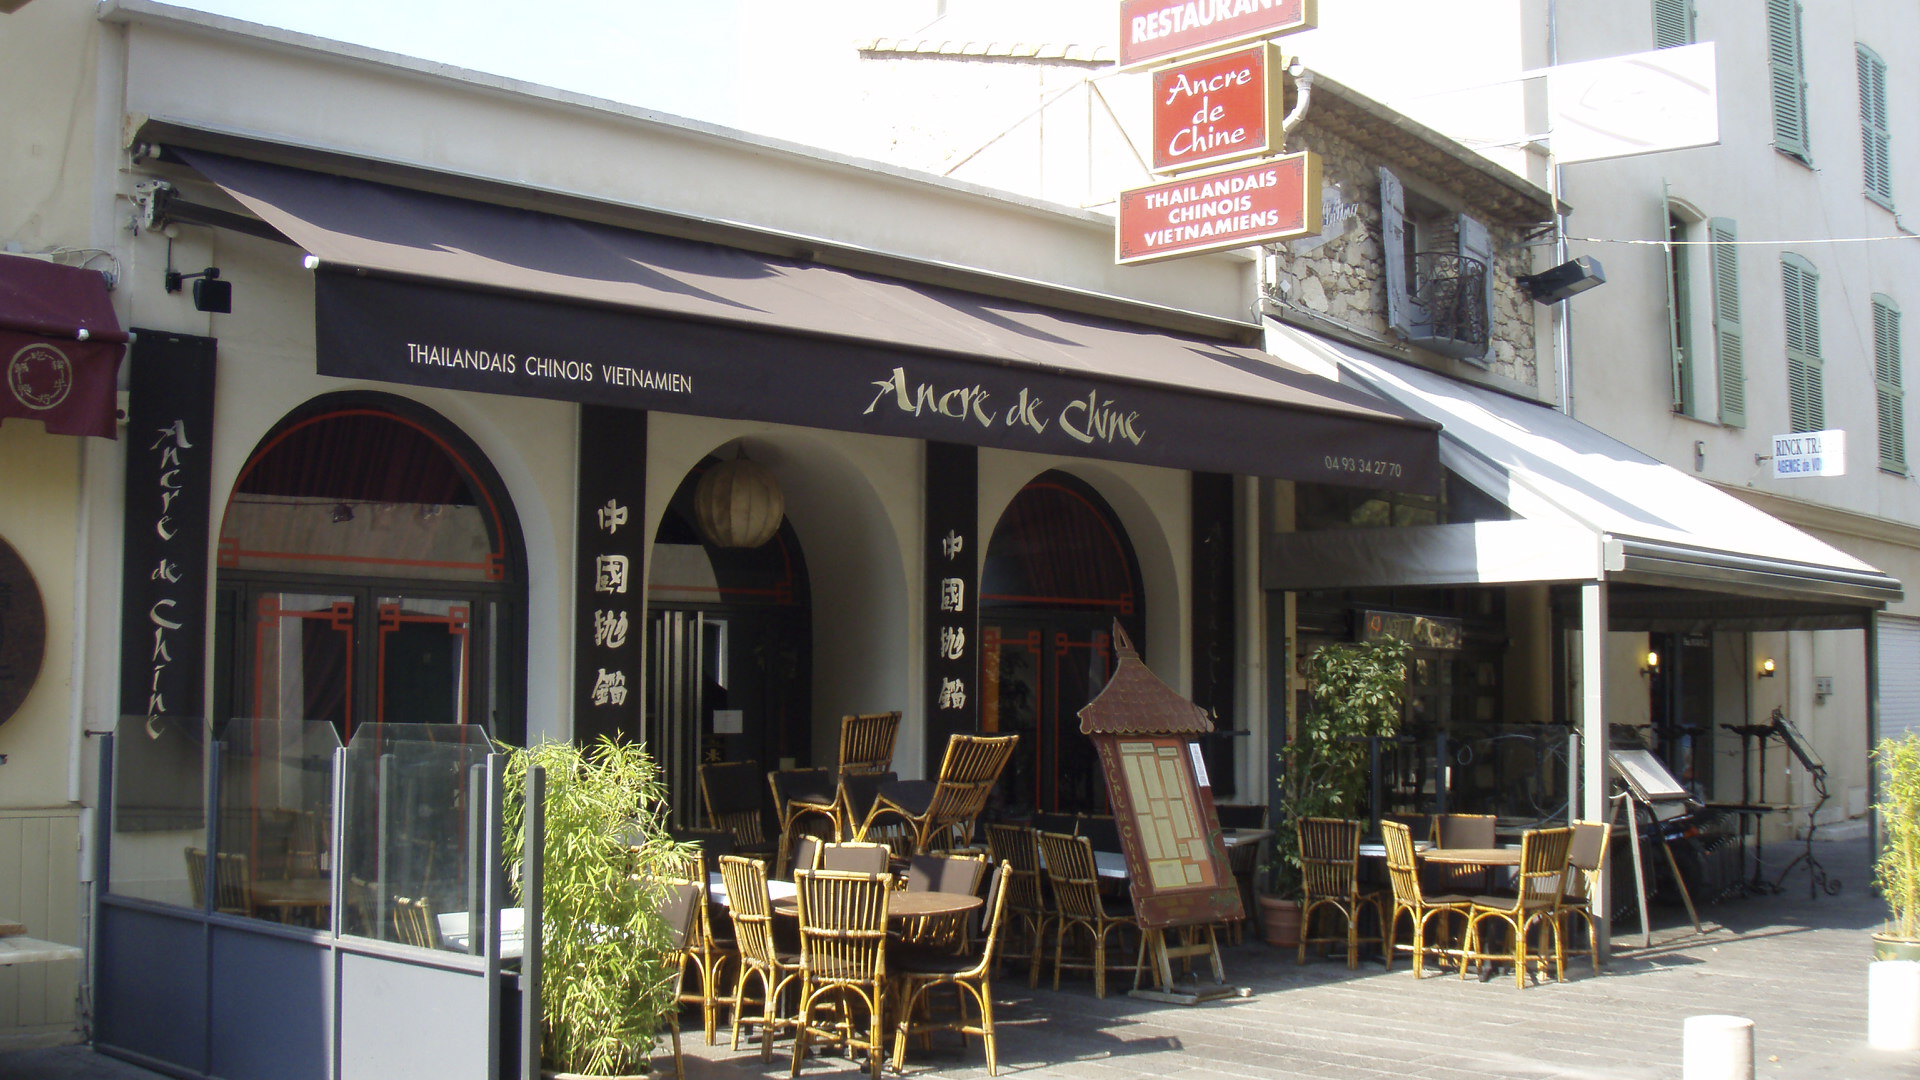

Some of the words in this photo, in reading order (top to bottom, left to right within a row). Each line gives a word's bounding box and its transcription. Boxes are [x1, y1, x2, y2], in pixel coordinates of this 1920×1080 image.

[1166, 68, 1251, 105] Ancre
[1192, 96, 1225, 124] de
[1168, 125, 1246, 156] Chine
[1145, 170, 1277, 209] THAILANDAIS
[1144, 209, 1279, 247] VIETNAMIENS
[1168, 195, 1252, 224] CHINOIS
[407, 343, 516, 374] THAILANDAIS
[525, 356, 593, 382] CHINOIS
[602, 364, 692, 394] VIETNAMIEN
[863, 367, 997, 428] Ancre
[1005, 387, 1049, 434] de
[1059, 389, 1146, 445] Chine
[1324, 455, 1339, 470] 04
[1341, 457, 1356, 472] 93
[1359, 459, 1372, 473] 34
[1374, 461, 1387, 475] 27
[1388, 462, 1402, 477] 70
[1775, 439, 1803, 457] RINCK
[150, 419, 193, 541] Ancre
[151, 558, 182, 583] de
[145, 598, 182, 740] Chine
